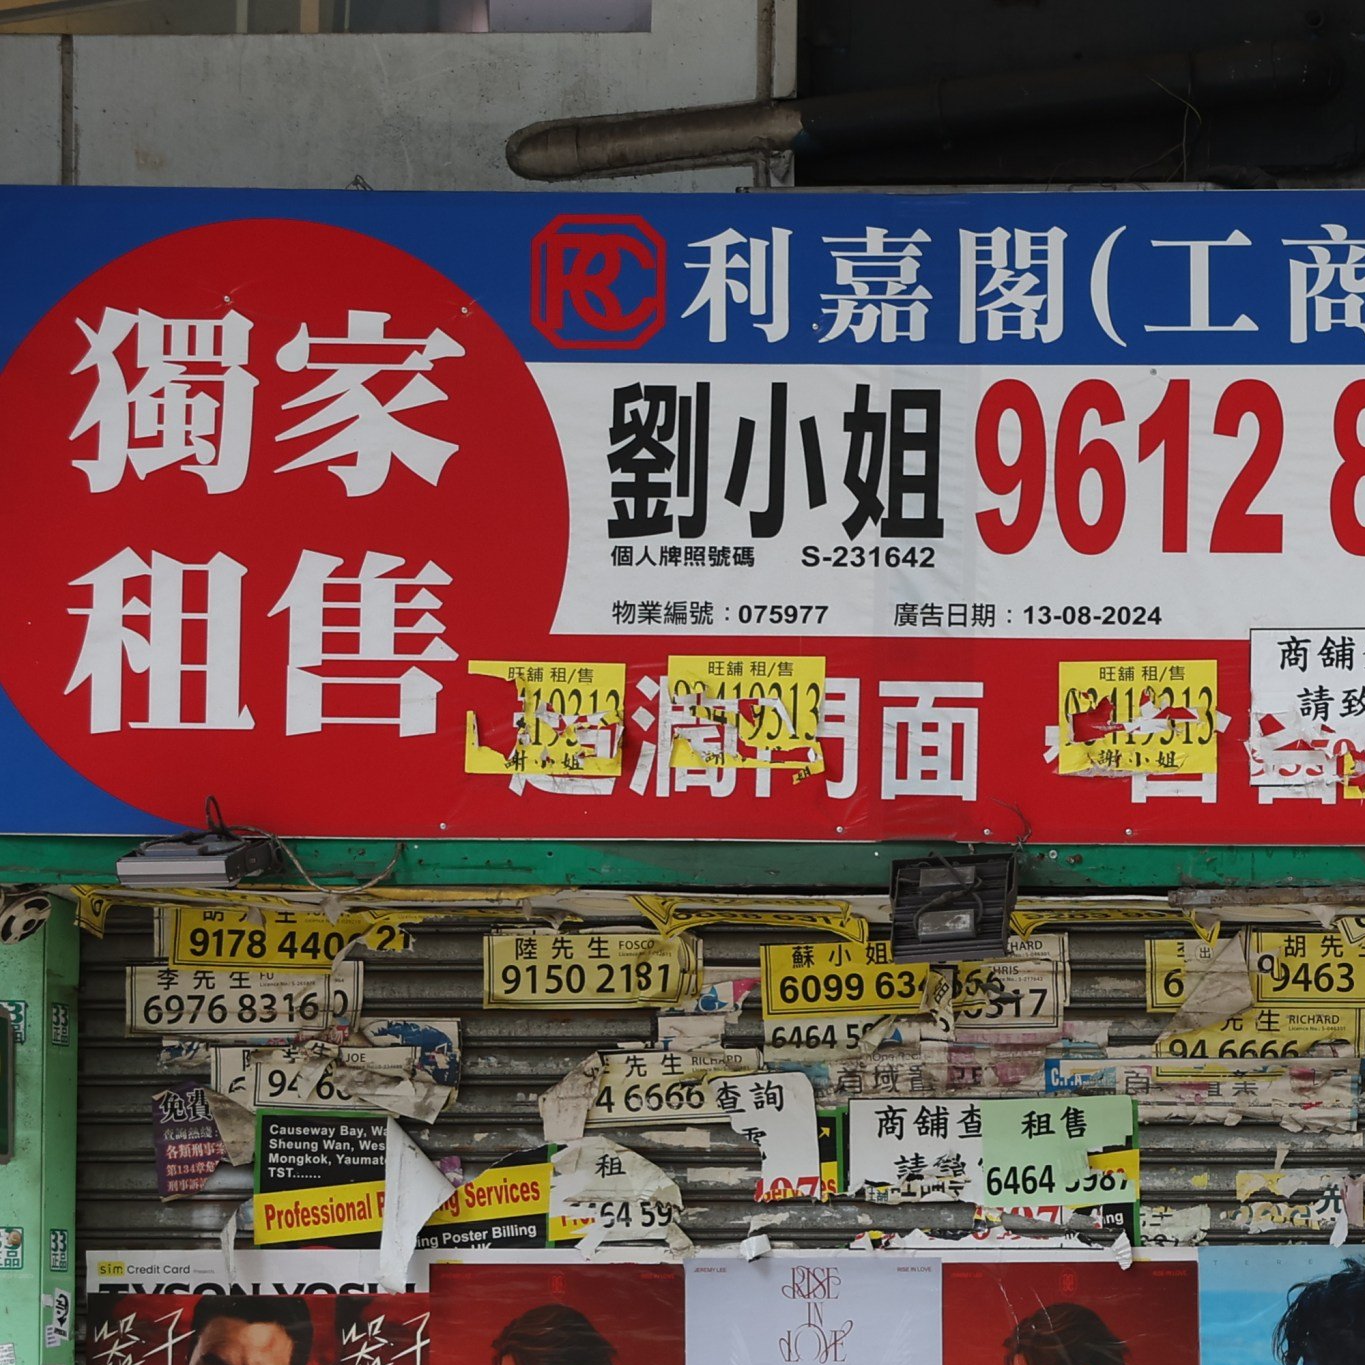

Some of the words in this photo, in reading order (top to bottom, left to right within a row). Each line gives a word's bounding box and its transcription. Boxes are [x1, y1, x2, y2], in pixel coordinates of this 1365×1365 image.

[68, 306, 467, 498] 獨家
[607, 381, 944, 541] 劉小姐
[974, 378, 1285, 557] 9612
[610, 545, 756, 570] 個人牌照號碼
[801, 546, 936, 569] S-231642
[63, 546, 459, 738] 租售
[188, 928, 267, 959] 9178
[514, 938, 611, 961] 陸先生
[618, 940, 655, 951] FOSCO
[501, 963, 586, 994] 9150
[596, 963, 671, 994] 2181
[779, 972, 865, 1004] 6099
[1271, 963, 1355, 994] 9463
[142, 994, 229, 1025] 6976
[237, 992, 320, 1023] 8316
[269, 1125, 337, 1139] Causeway
[340, 1125, 367, 1139] Bay,
[1021, 1106, 1089, 1139] 租售
[269, 1139, 320, 1153] Sheung
[322, 1140, 356, 1153] Wan,
[269, 1153, 333, 1167] Mongkok,
[986, 1165, 1057, 1196] 6464
[265, 1190, 373, 1231] Professional
[464, 1177, 541, 1209] Services
[442, 1226, 488, 1247] Poster
[491, 1222, 537, 1242] Billing
[99, 1264, 125, 1277] sim
[127, 1264, 161, 1276] Credit
[164, 1264, 191, 1276] Card
